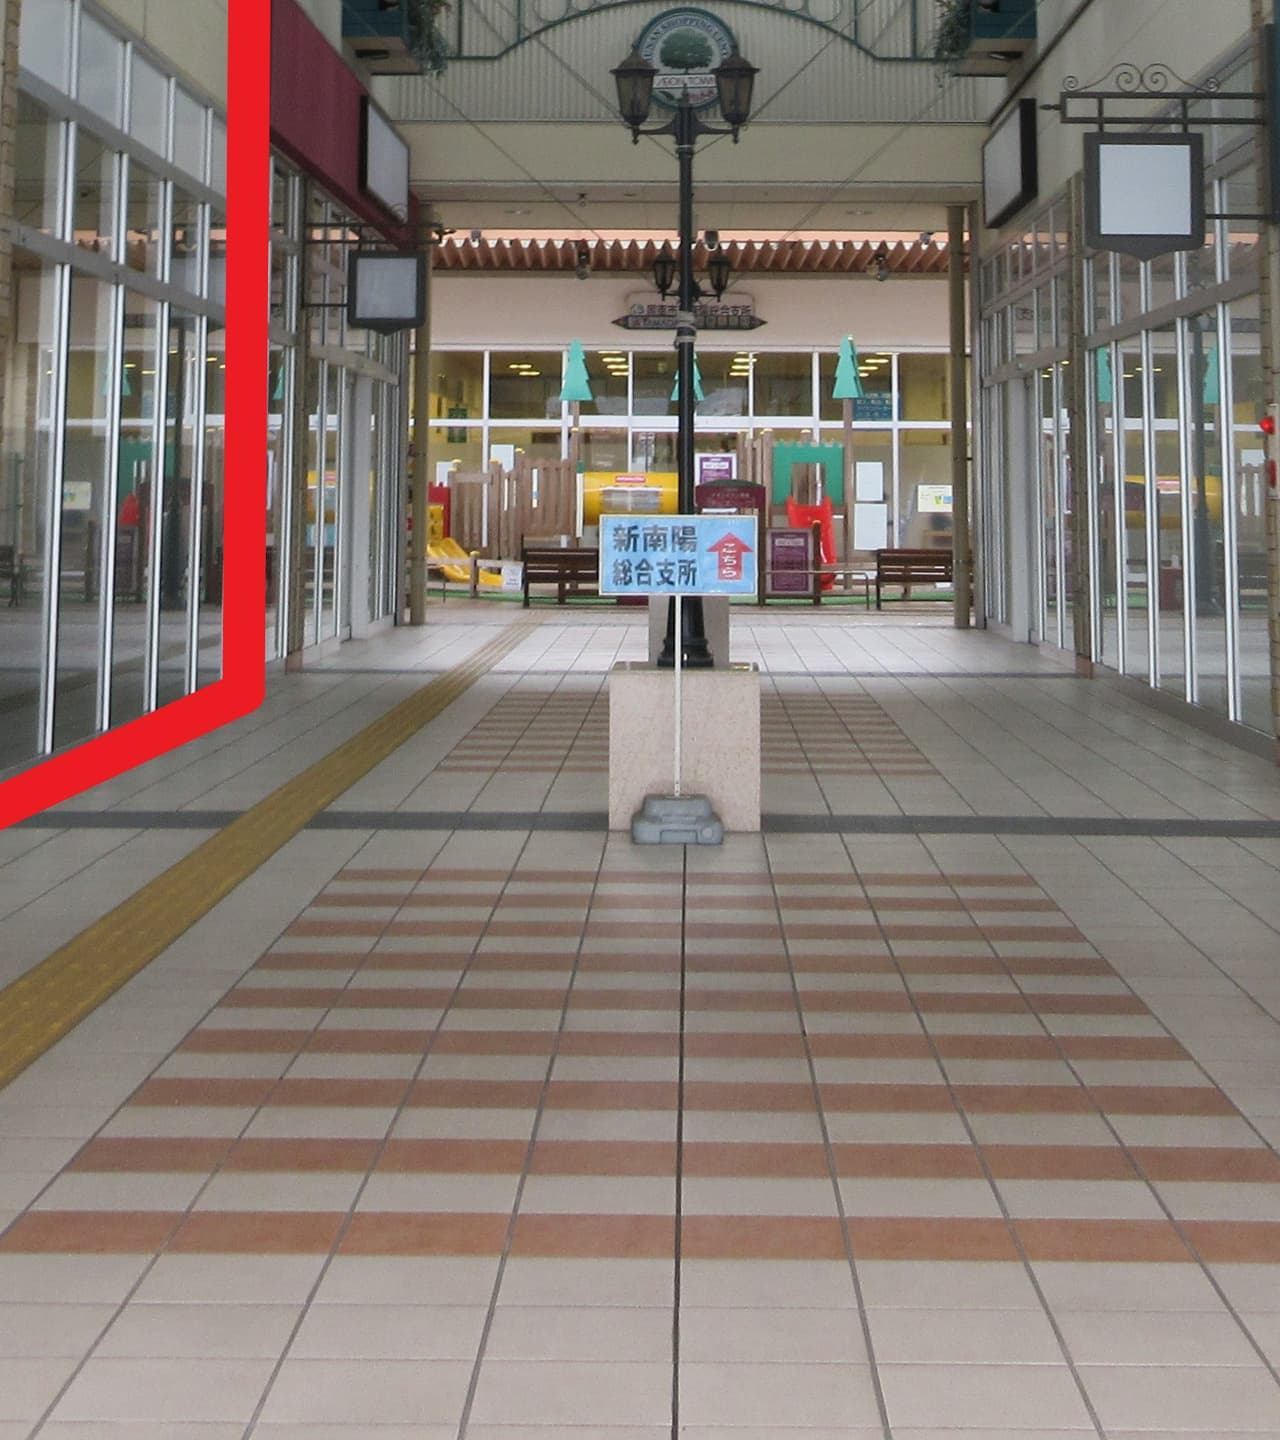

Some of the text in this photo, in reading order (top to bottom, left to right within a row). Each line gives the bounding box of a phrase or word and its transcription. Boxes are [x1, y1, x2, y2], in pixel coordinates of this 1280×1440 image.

[612, 524, 698, 553] 新南陽
[612, 558, 698, 587] 総合支所
[722, 542, 737, 578] こちら
